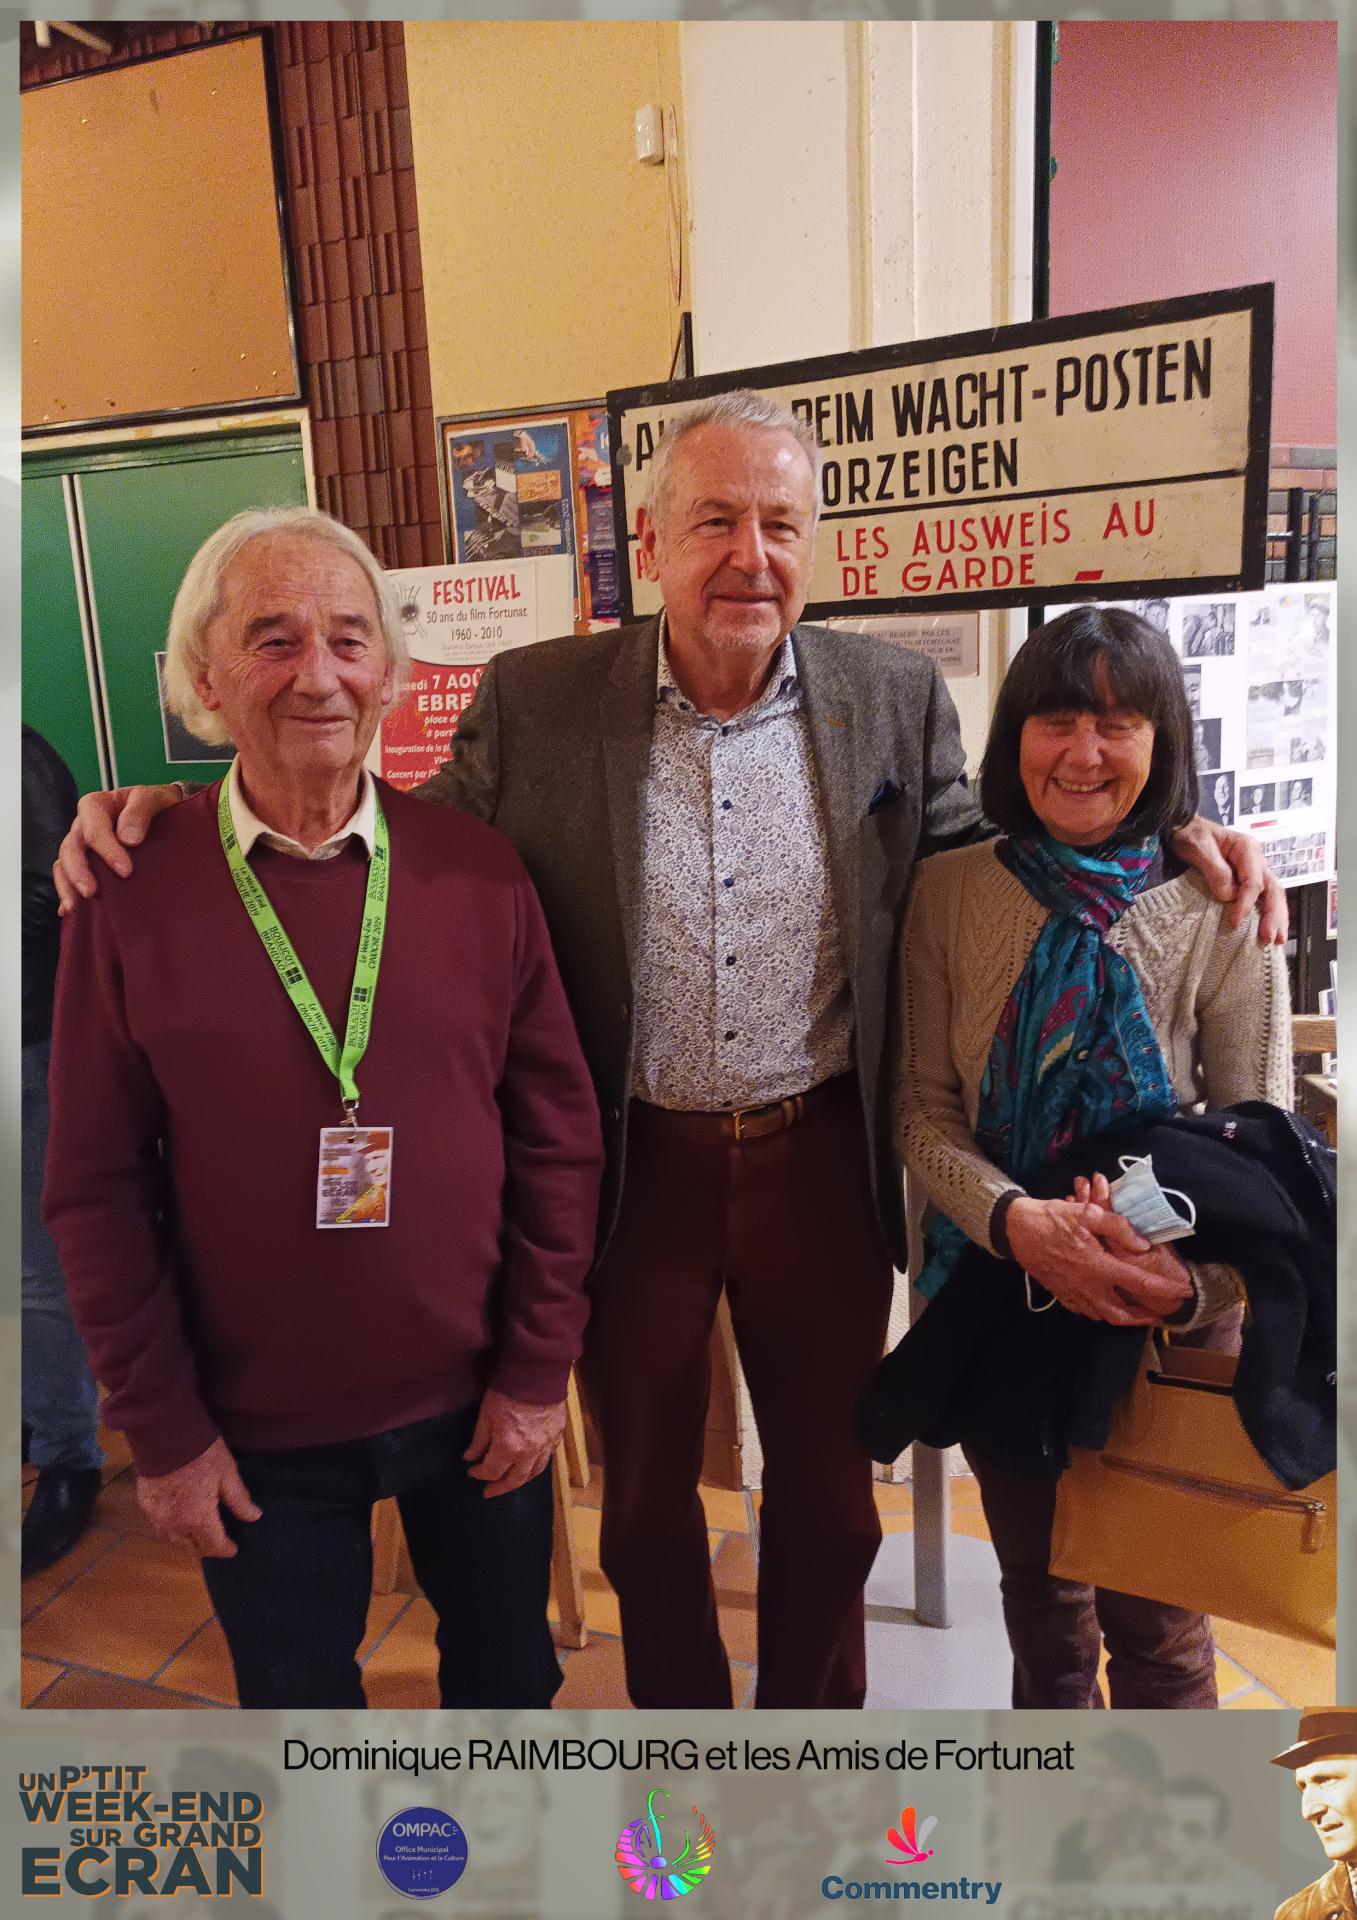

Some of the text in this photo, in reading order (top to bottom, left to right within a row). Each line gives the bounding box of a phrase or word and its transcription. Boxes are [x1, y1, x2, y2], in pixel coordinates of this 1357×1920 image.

[891, 337, 1213, 438] WACHT-POSTEN
[821, 438, 1018, 508] ORZEIGEN
[837, 526, 890, 562] LES
[1102, 498, 1155, 540] AU
[842, 553, 1036, 597] DE GARDE
[433, 575, 521, 605] FESTIVAL
[439, 612, 455, 623] ans
[456, 608, 469, 622] du
[469, 608, 486, 621] film
[488, 606, 529, 619] Fortunat
[450, 627, 473, 643] 1960
[480, 625, 504, 640] 2010
[431, 673, 441, 690] 7
[417, 692, 474, 712] EBRE
[424, 713, 449, 727] place
[386, 769, 414, 779] Concert
